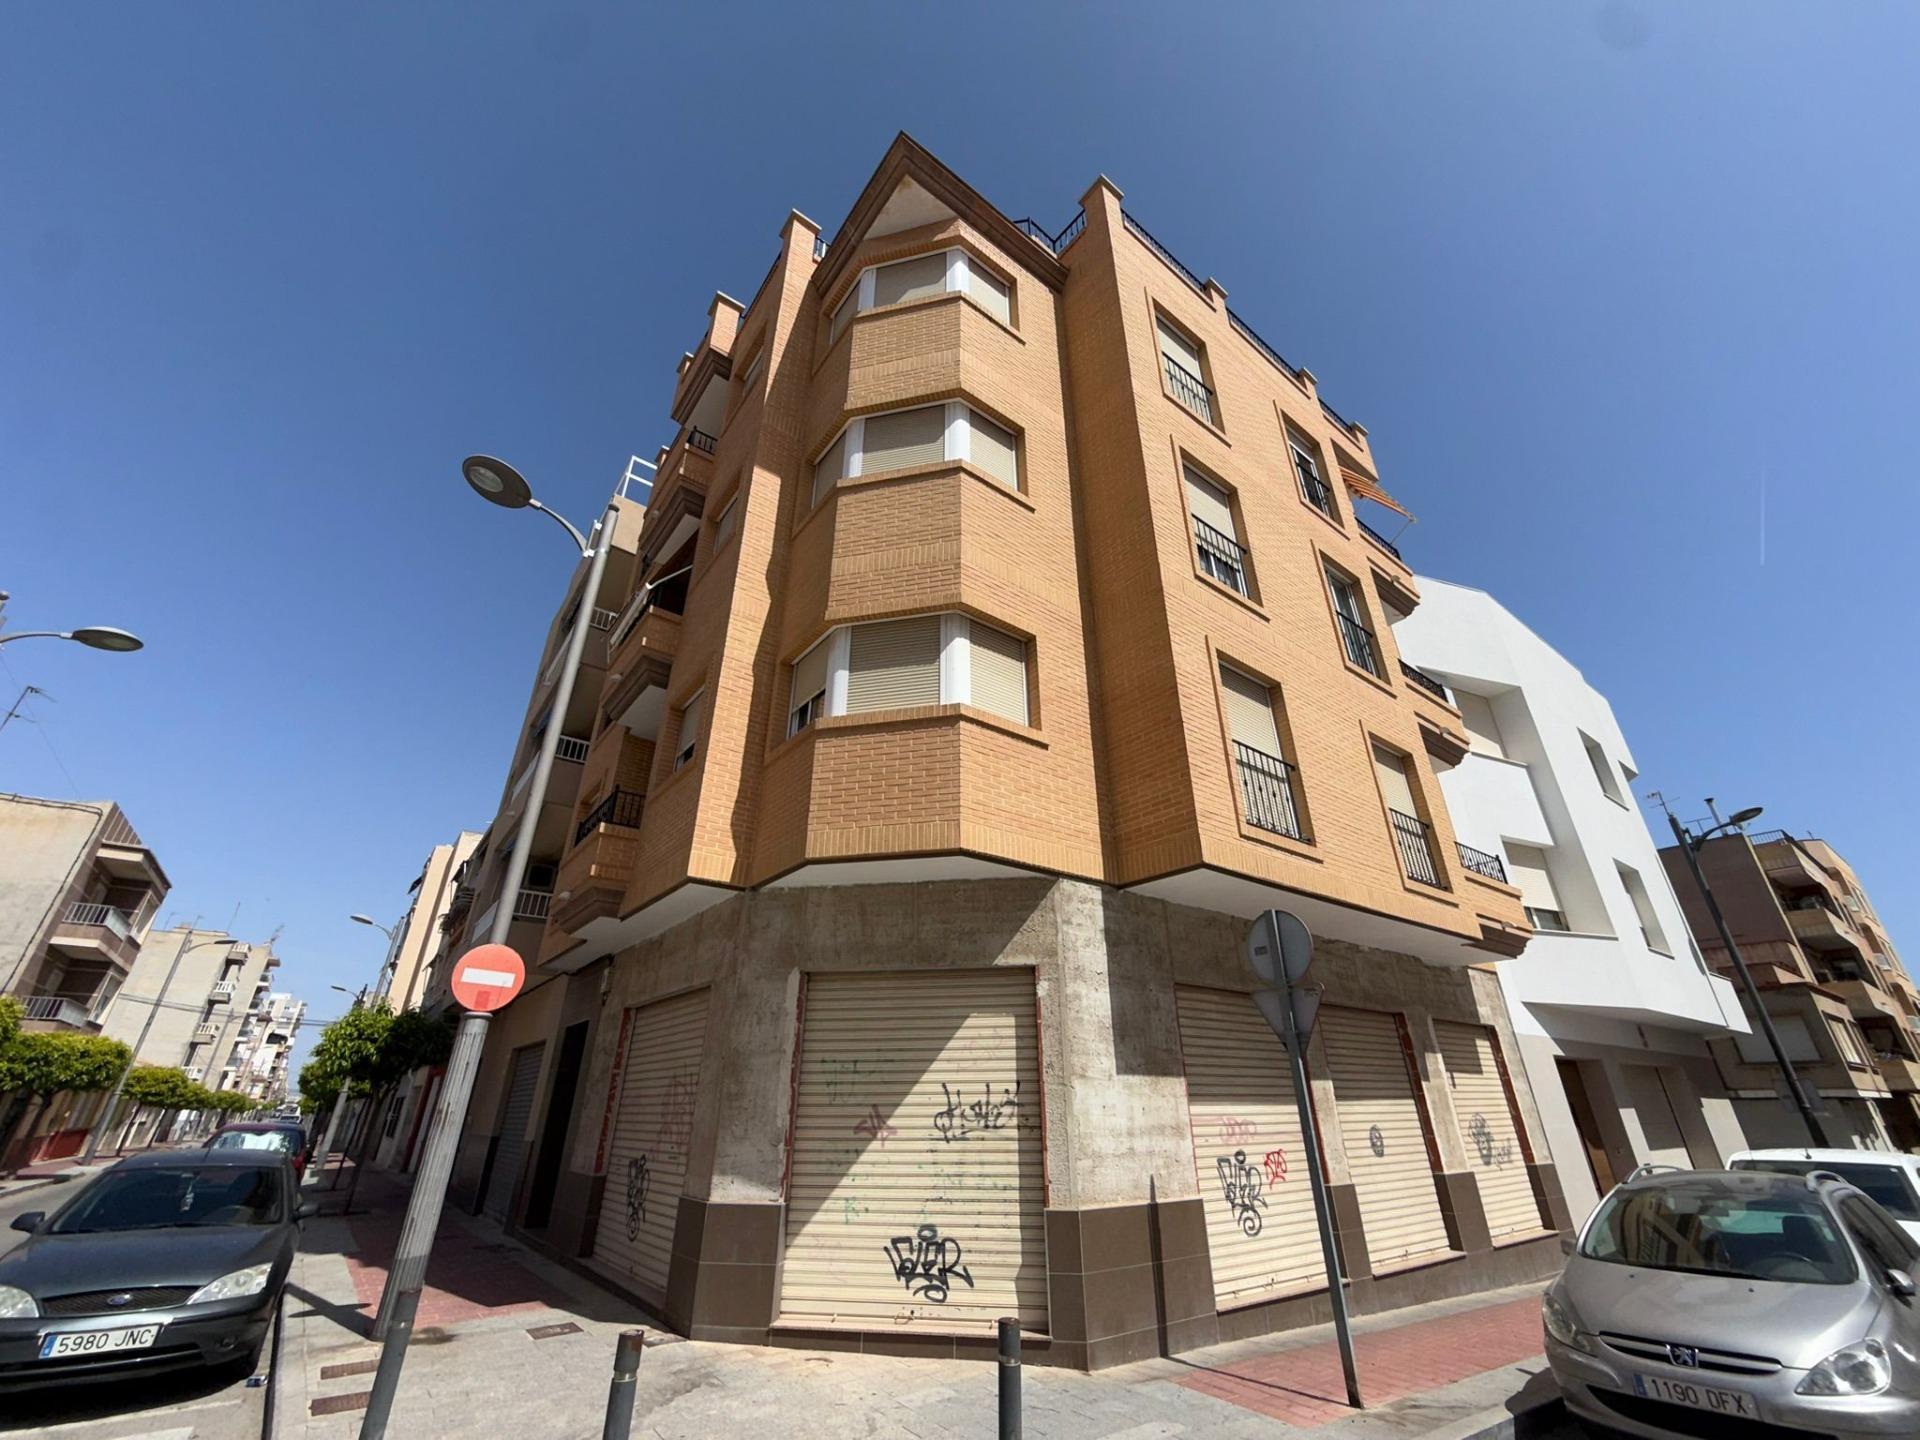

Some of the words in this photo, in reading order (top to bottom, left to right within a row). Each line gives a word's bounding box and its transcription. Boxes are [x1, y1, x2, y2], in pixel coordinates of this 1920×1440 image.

[57, 1332, 110, 1354] 5980
[114, 1328, 152, 1347] JNC
[1651, 1378, 1699, 1406] 1190
[1705, 1388, 1749, 1415] DFX
